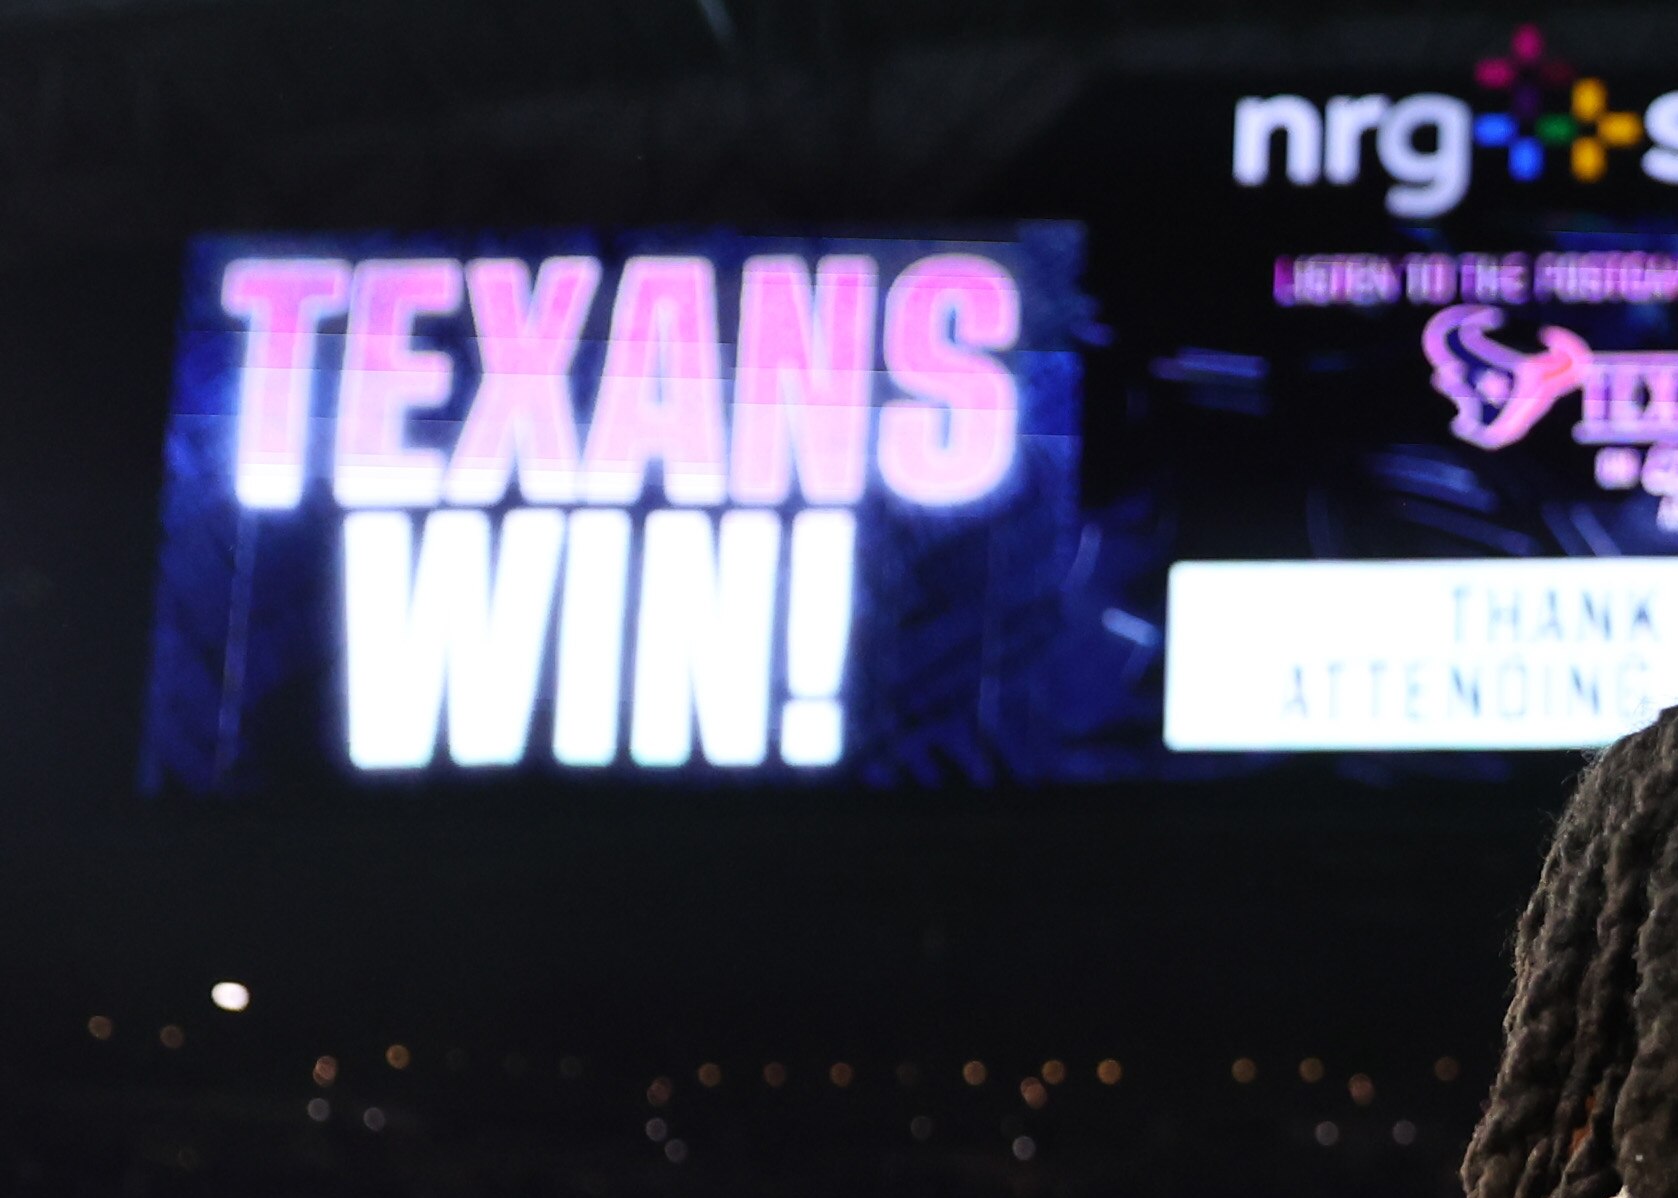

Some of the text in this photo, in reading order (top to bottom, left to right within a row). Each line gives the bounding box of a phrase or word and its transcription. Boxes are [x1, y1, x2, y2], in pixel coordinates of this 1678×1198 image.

[1232, 94, 1474, 218] nrg
[221, 254, 1022, 510] TEXANS
[342, 509, 858, 769] WIN!
[1452, 584, 1659, 642] THANK
[1284, 660, 1650, 720] ATTENDING
